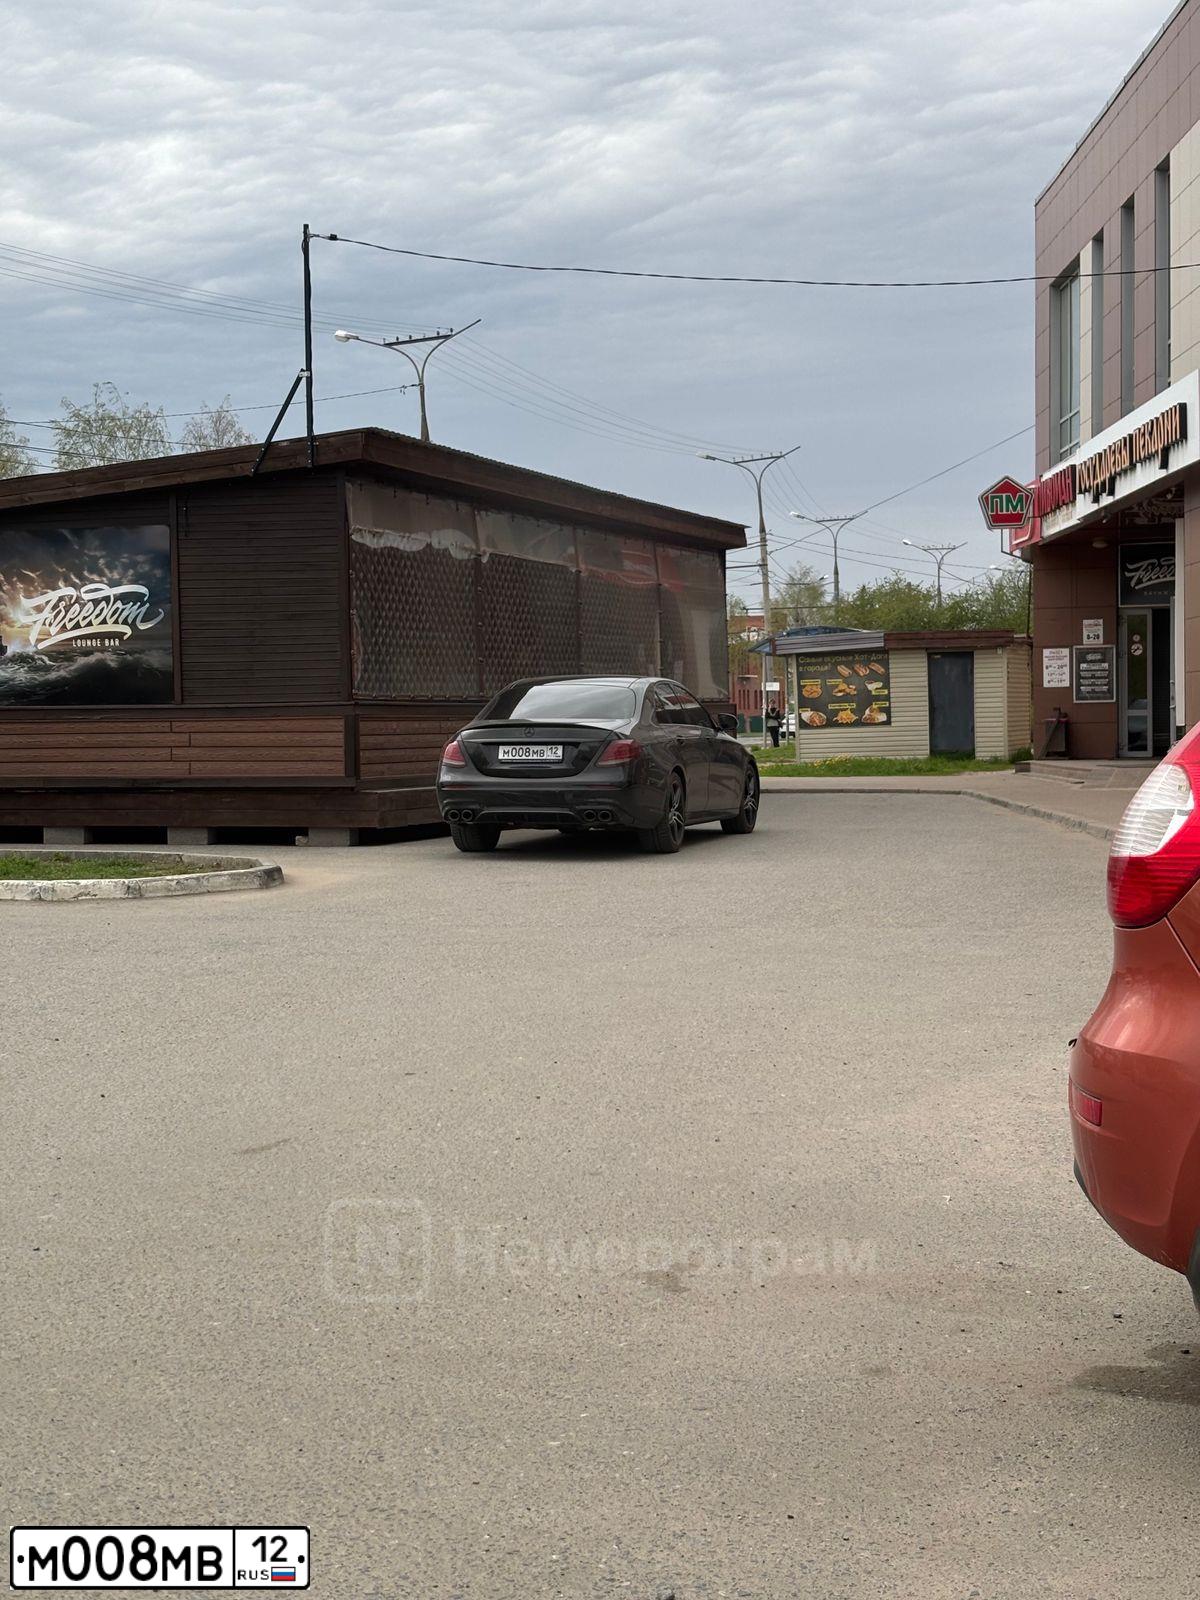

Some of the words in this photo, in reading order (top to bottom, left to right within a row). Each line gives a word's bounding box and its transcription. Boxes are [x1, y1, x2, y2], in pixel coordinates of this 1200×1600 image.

[989, 493, 1025, 514] ПМ
[19, 583, 165, 650] Freedom
[72, 638, 101, 647] LOUNGE
[105, 638, 120, 647] BAR
[549, 746, 559, 755] 12
